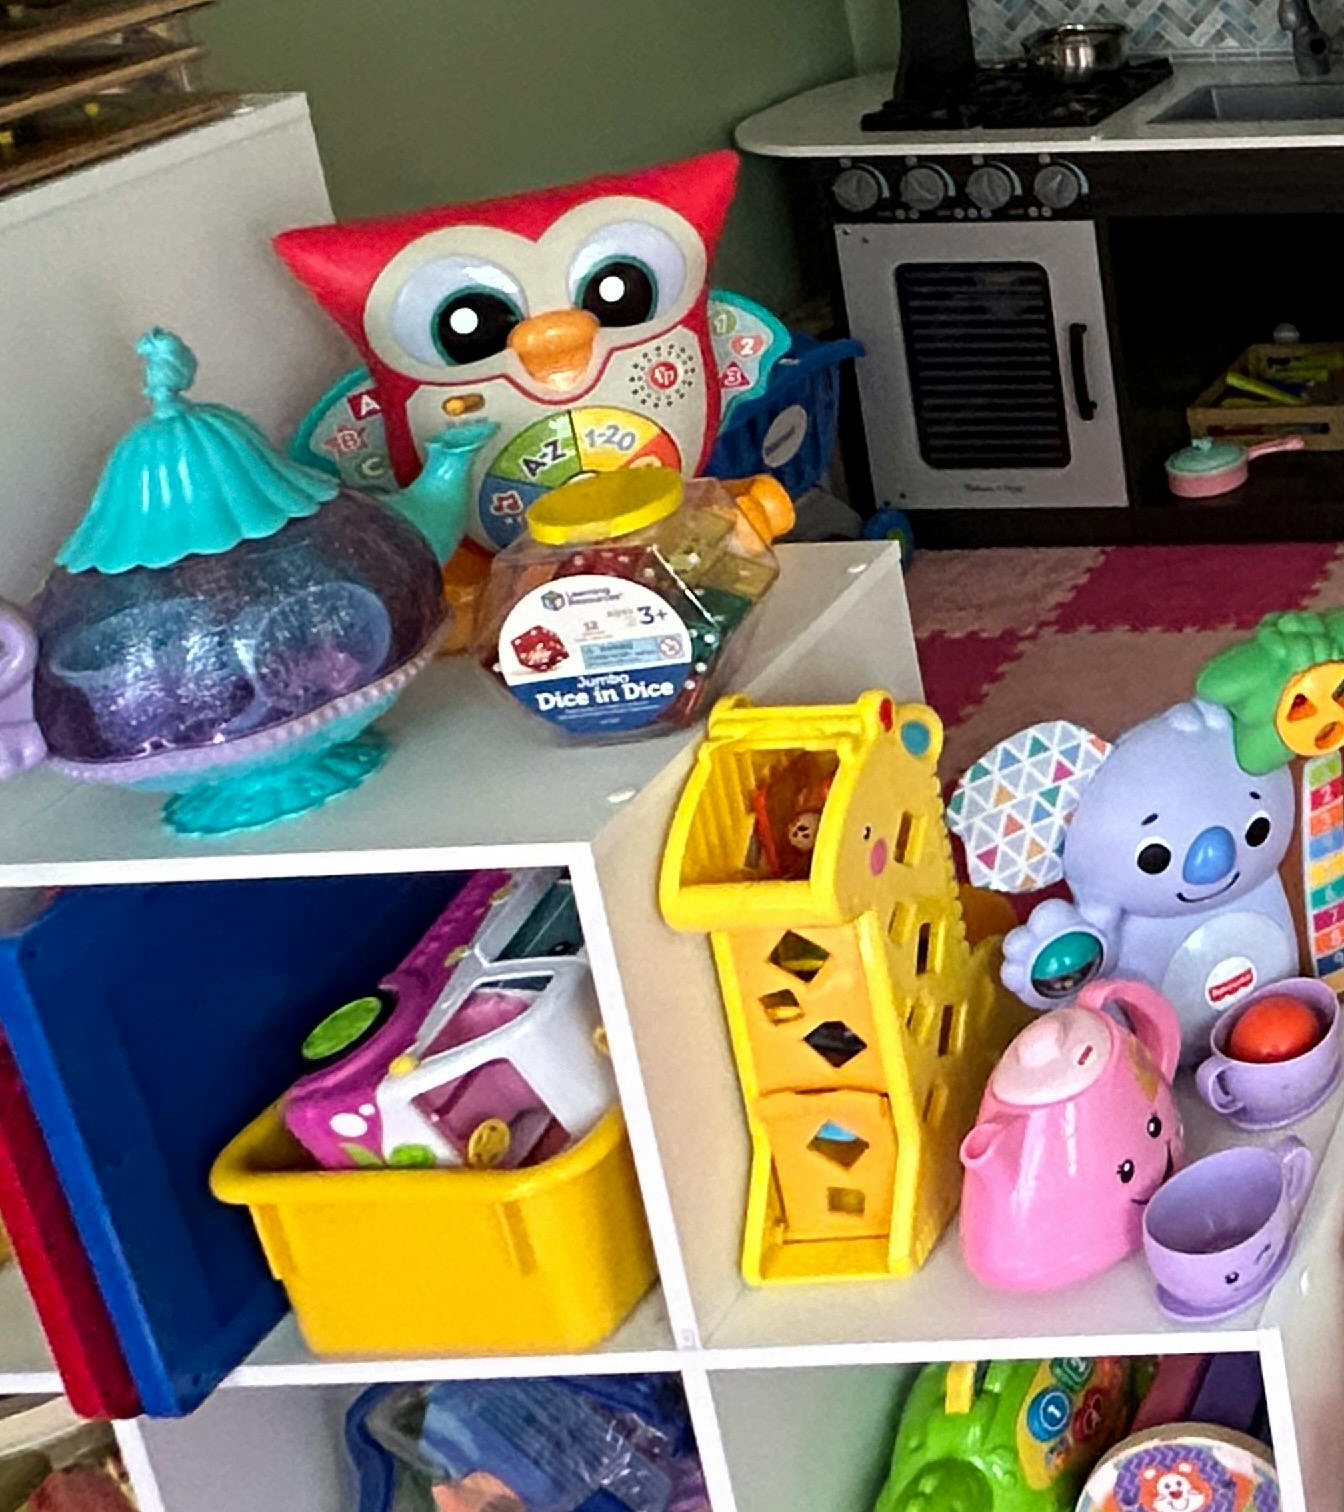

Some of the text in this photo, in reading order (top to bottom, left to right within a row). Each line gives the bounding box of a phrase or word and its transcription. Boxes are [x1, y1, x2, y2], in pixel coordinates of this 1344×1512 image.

[740, 337, 755, 356] 2
[724, 367, 742, 386] 3
[360, 394, 381, 416] A
[584, 424, 636, 451] 1-20
[361, 457, 384, 475] C
[521, 438, 567, 478] A-Z
[637, 605, 668, 625] 3+
[576, 673, 630, 690] Jumbo
[535, 680, 675, 712] Dice in Dice
